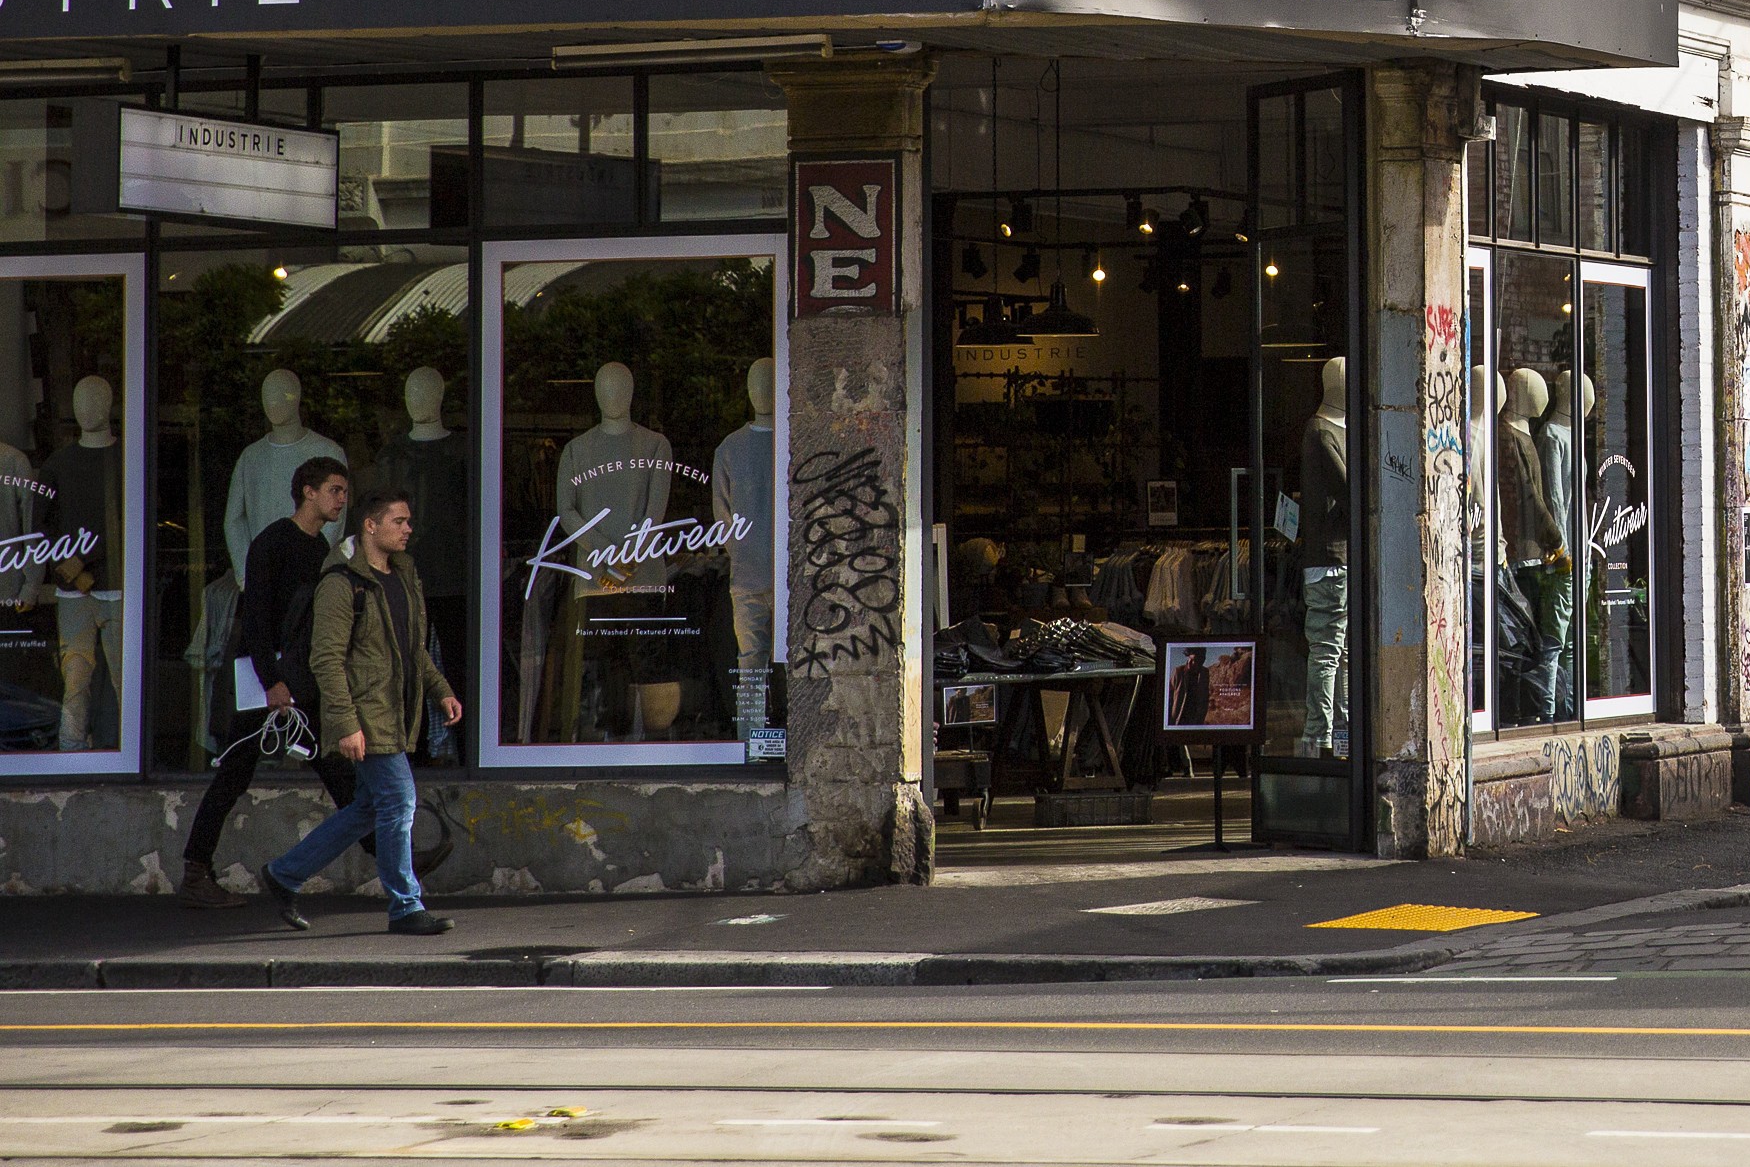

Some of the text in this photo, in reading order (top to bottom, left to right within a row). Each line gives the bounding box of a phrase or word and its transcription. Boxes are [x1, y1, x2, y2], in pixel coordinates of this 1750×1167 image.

[178, 124, 285, 156] INDUSTRIE
[808, 185, 881, 318] NE
[957, 347, 1087, 361] INDUSTRIE
[571, 459, 709, 486] WINTER SEVENTEEN
[0, 475, 56, 499] ENTEEN
[1587, 496, 1647, 572] Knitwear
[0, 527, 99, 572] wear
[524, 507, 753, 600] Knitwear
[602, 585, 675, 594] COLLECTION
[575, 628, 593, 636] Plain
[673, 627, 700, 635] Waffled
[751, 730, 784, 738] NOTICE
